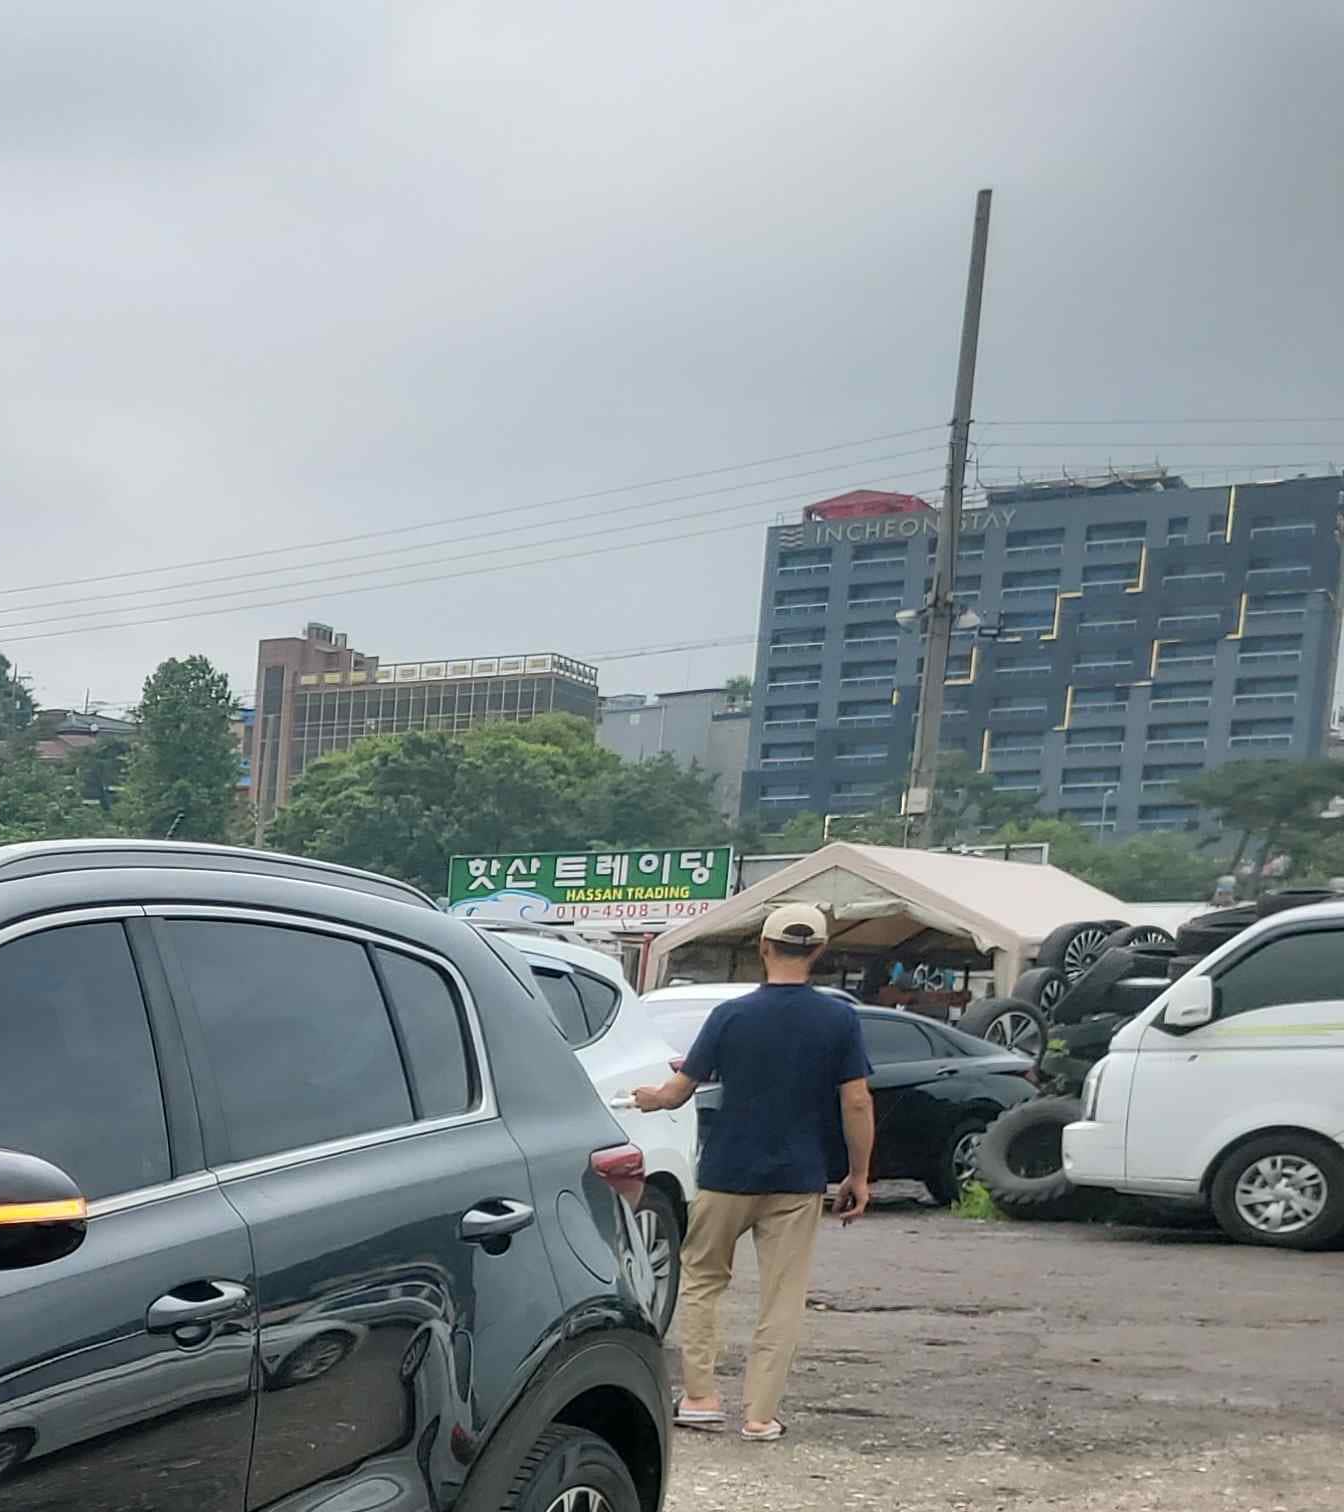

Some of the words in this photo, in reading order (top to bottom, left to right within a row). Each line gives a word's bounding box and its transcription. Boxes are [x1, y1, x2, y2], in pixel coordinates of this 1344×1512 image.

[815, 515, 941, 545] INCHEON
[960, 509, 1017, 532] STAY
[468, 858, 541, 891] 핫산
[553, 851, 715, 888] 트레이딩
[566, 888, 623, 902] HASSAN
[626, 885, 690, 900] TRADING
